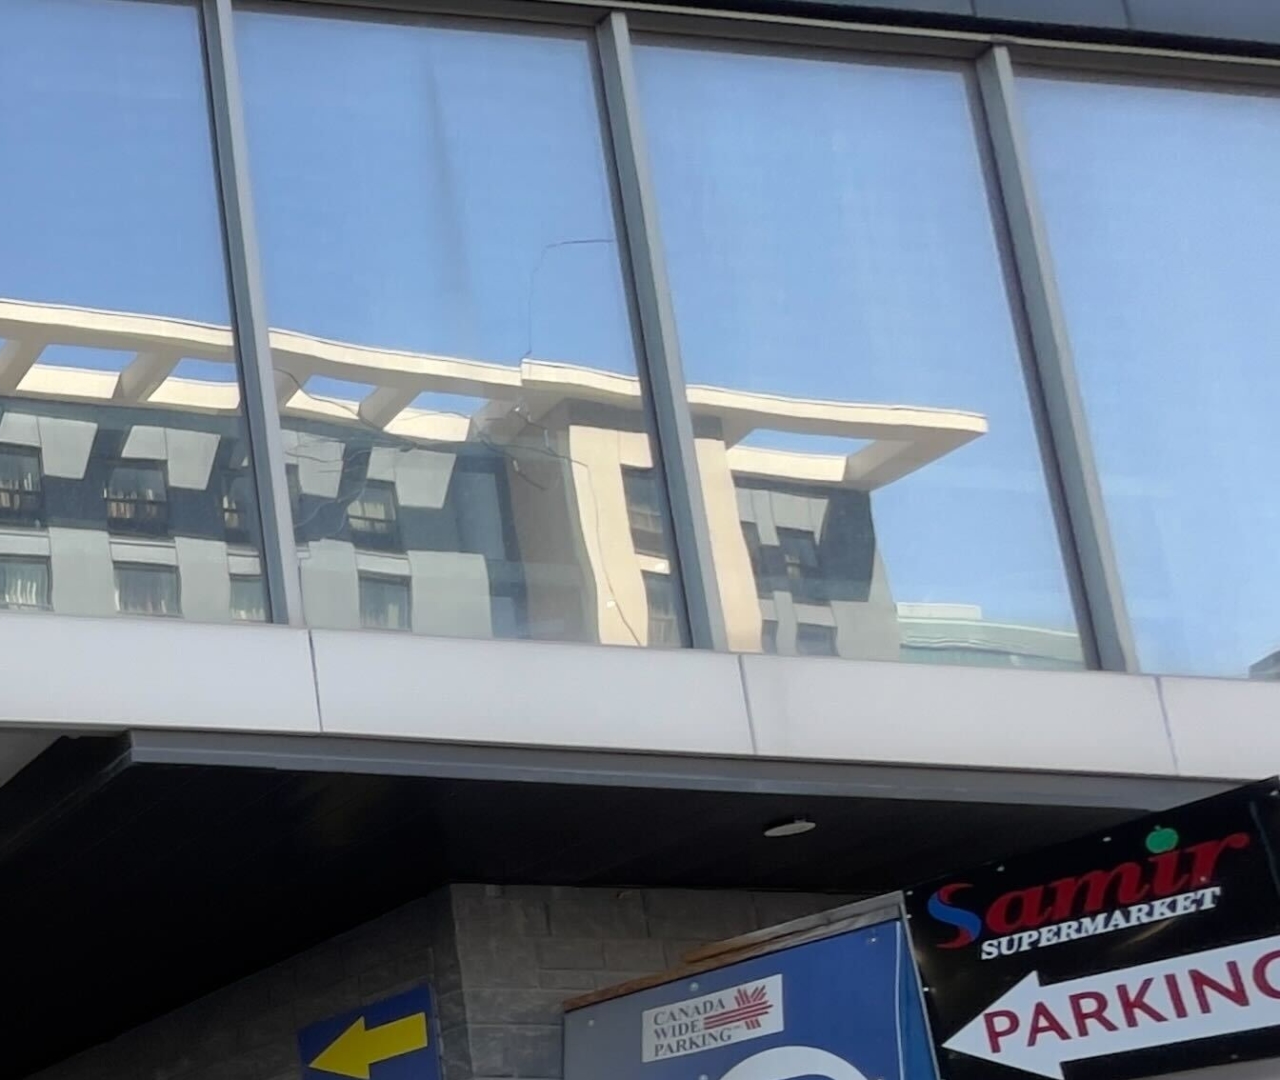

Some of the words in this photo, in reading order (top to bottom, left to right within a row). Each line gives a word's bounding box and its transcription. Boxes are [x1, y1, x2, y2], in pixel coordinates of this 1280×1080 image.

[928, 828, 1251, 949] Samir
[981, 886, 1221, 960] SUPERMARKET
[653, 997, 726, 1026] CANADA
[653, 1027, 732, 1058] PARKING
[654, 1019, 702, 1041] WIDE
